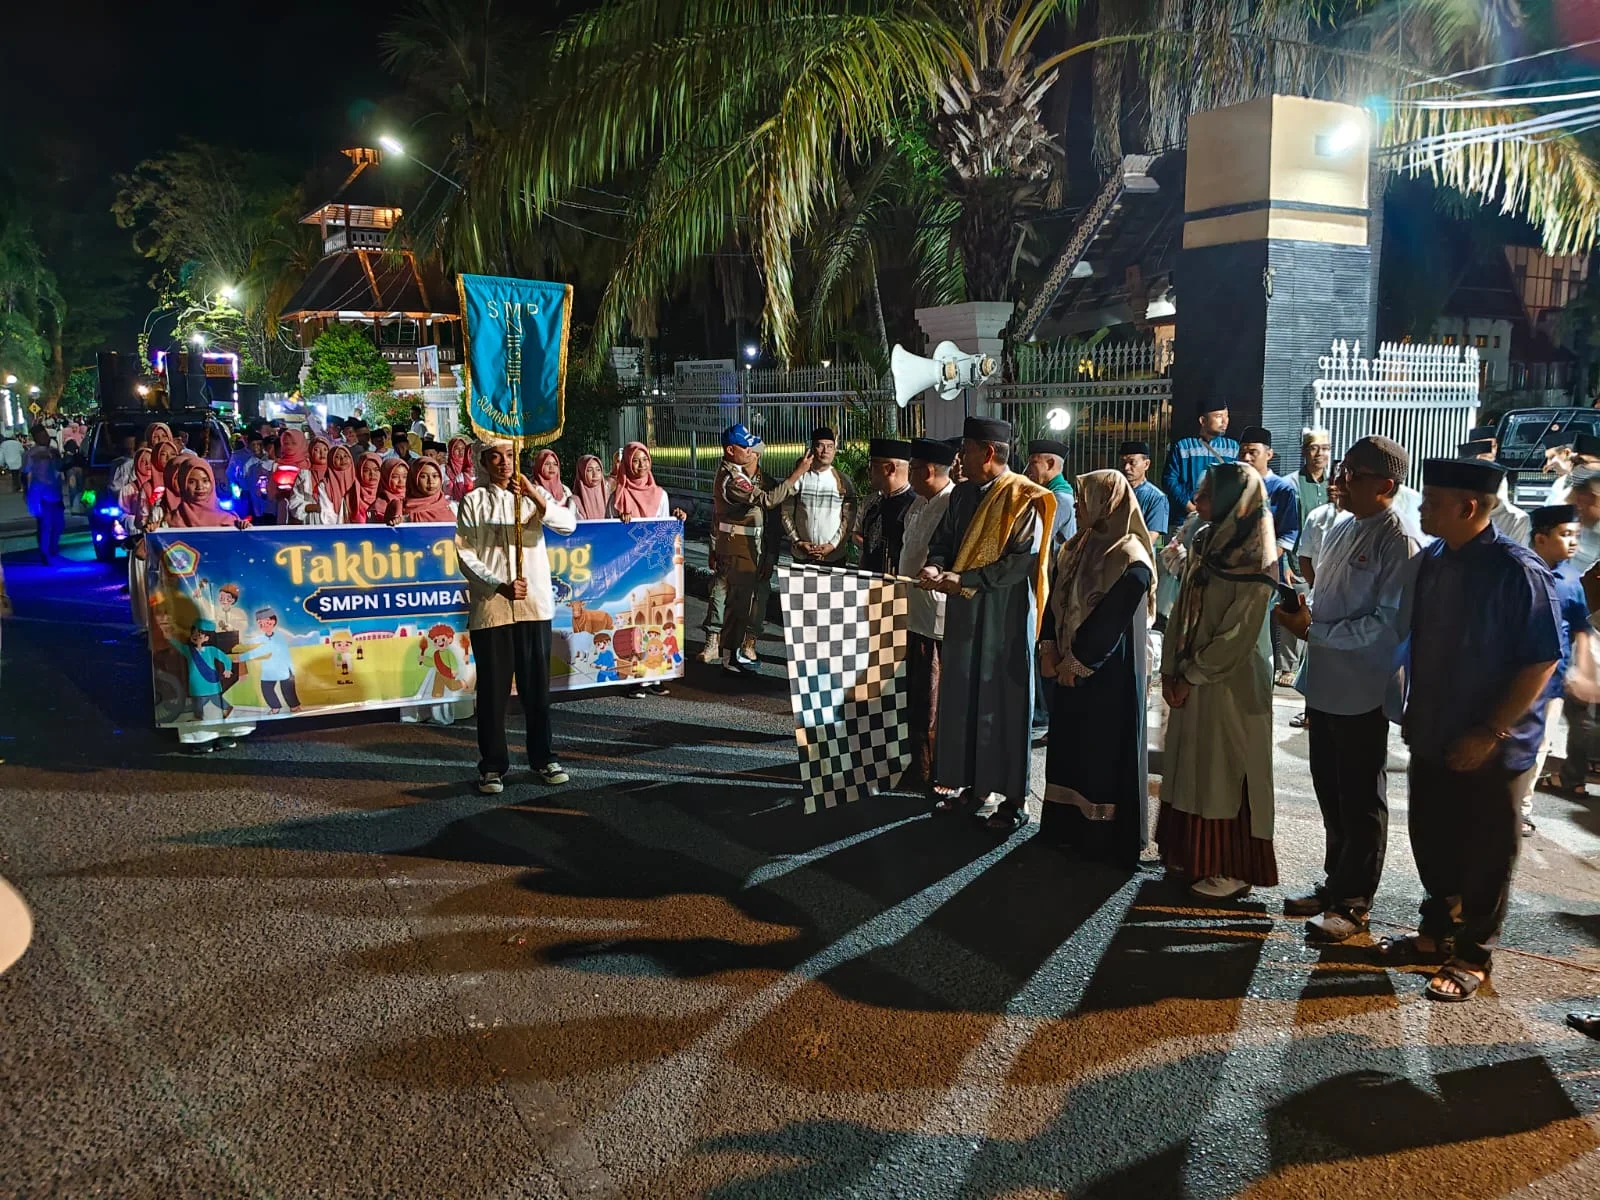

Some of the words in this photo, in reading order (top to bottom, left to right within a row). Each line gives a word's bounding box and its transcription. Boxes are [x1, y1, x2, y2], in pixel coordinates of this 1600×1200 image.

[487, 300, 539, 319] SMP
[274, 540, 423, 588] Takbir
[319, 595, 379, 612] SMPN
[383, 593, 391, 608] 1
